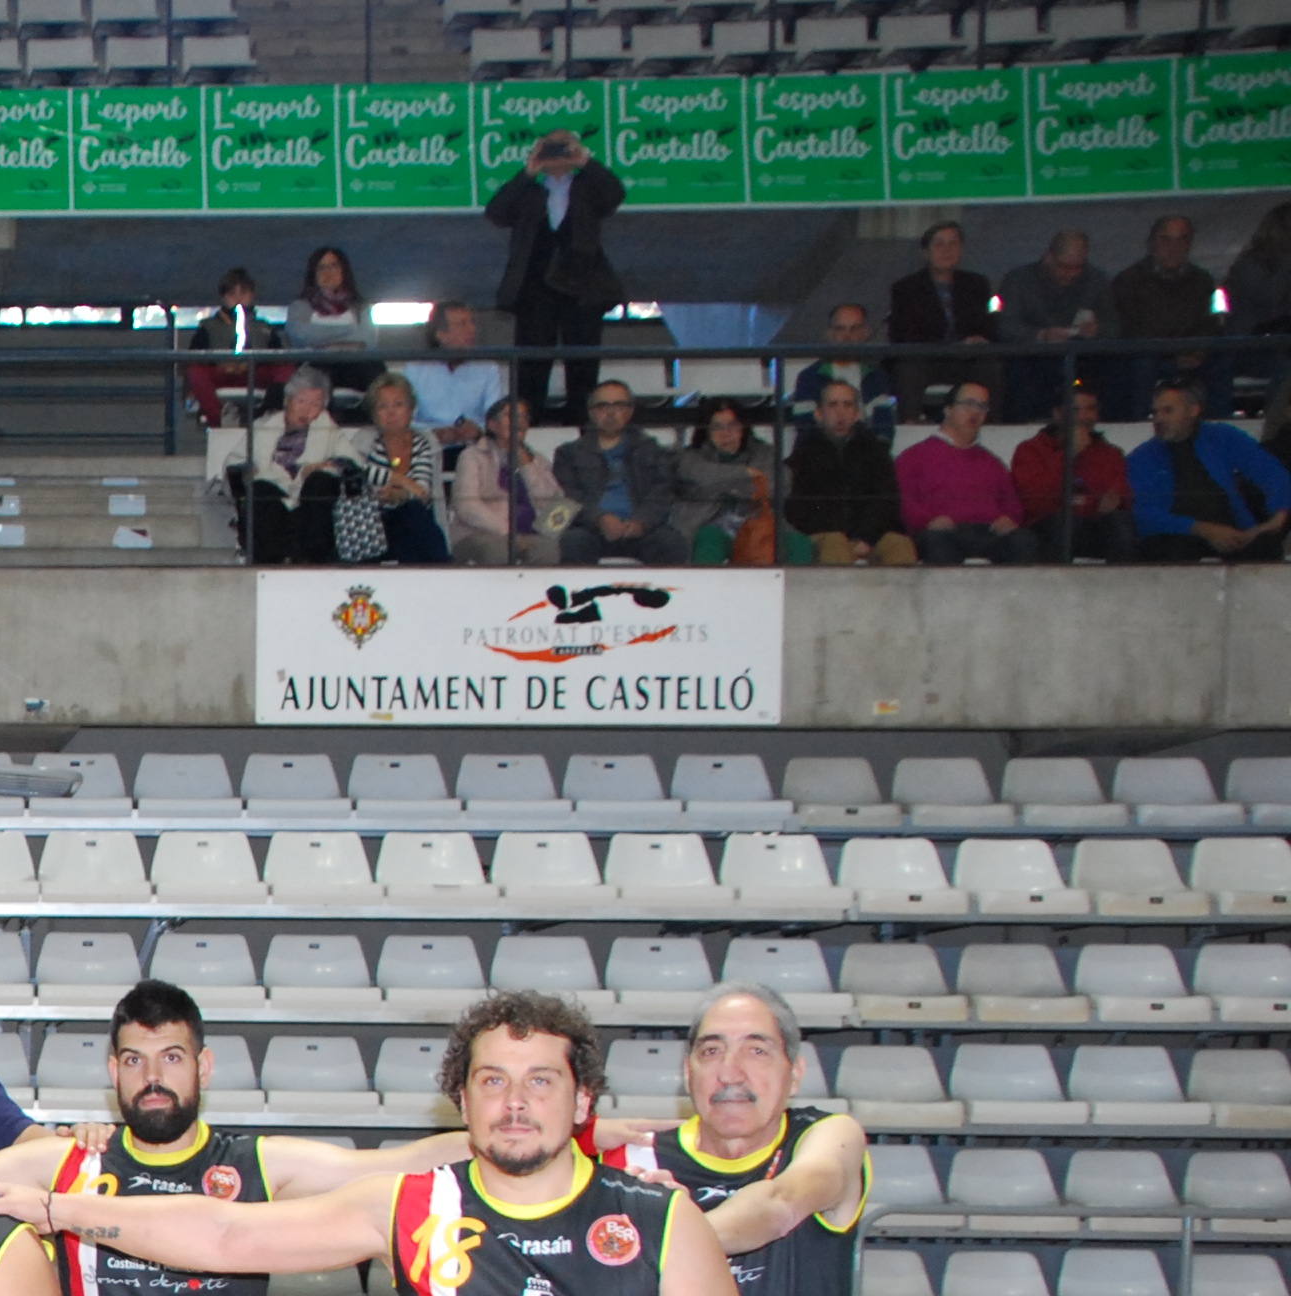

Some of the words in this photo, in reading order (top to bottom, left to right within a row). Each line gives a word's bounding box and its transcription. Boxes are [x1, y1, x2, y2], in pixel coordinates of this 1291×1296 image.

[462, 626, 578, 646] PATRONAT
[280, 675, 508, 711] AJUNTAMENT
[526, 675, 567, 711] DE
[585, 667, 755, 712] CASTELLÓ
[605, 1220, 635, 1242] BSR
[409, 1213, 487, 1288] 18
[521, 1235, 572, 1256] rasán
